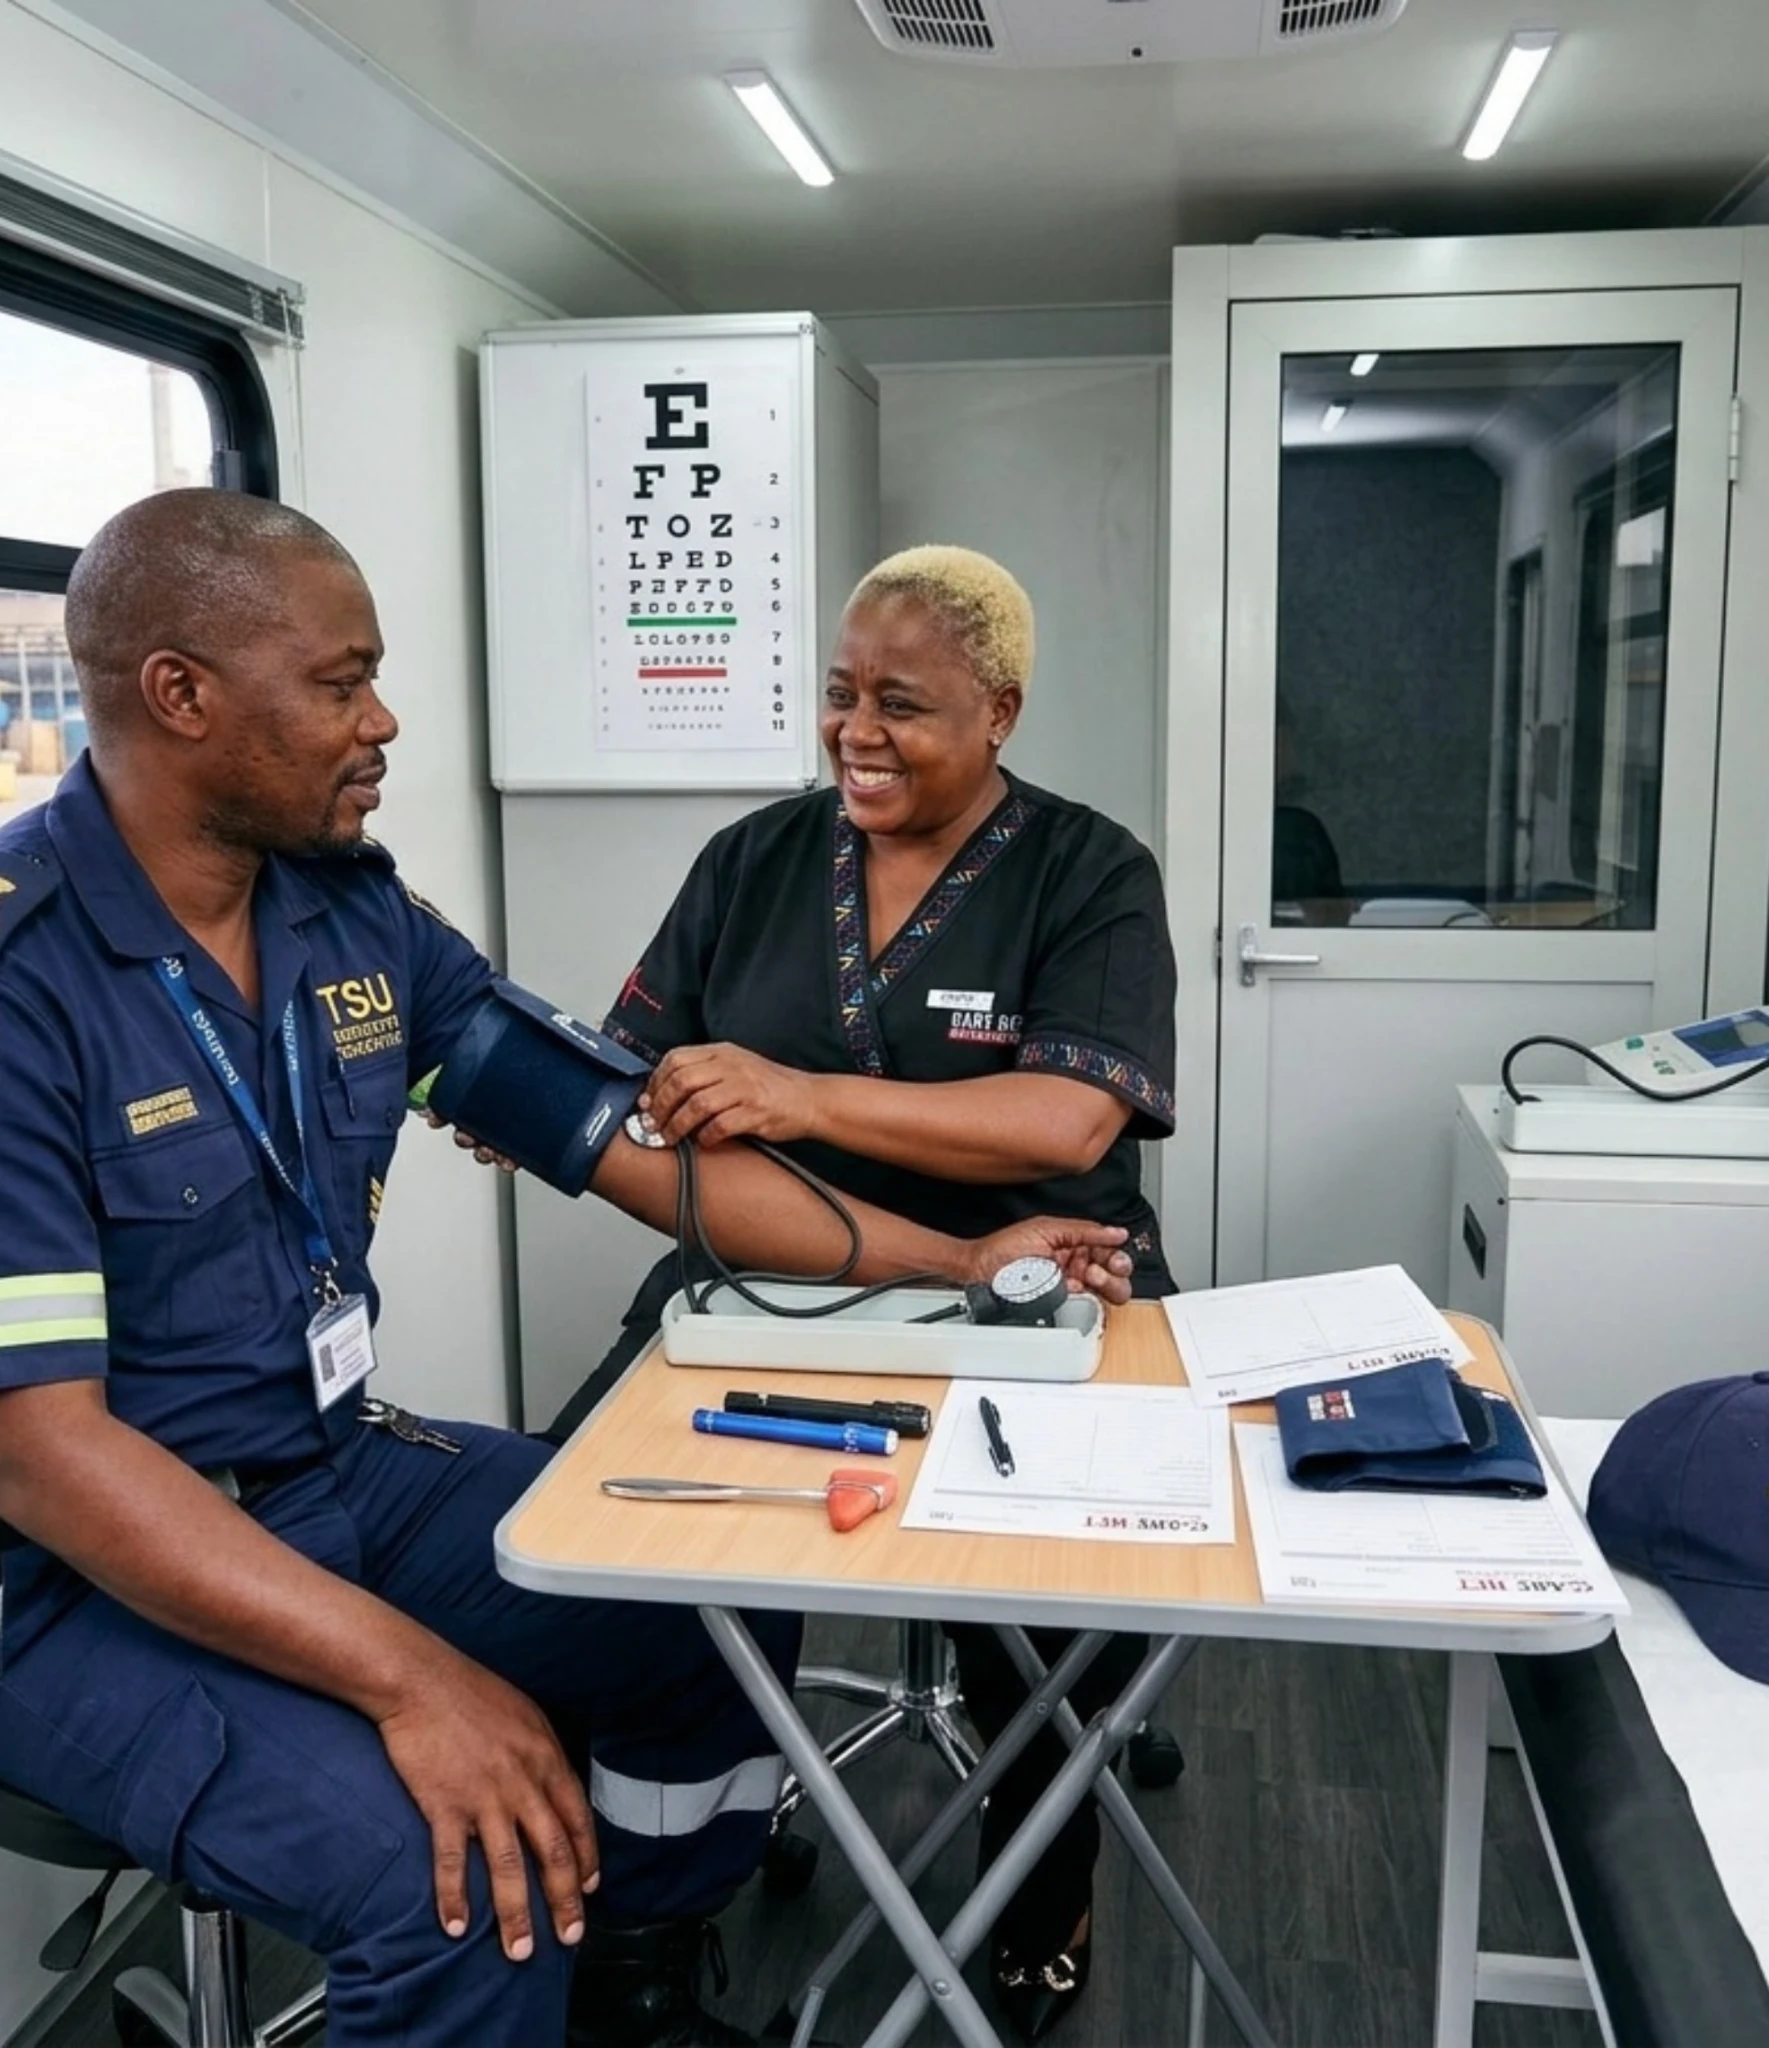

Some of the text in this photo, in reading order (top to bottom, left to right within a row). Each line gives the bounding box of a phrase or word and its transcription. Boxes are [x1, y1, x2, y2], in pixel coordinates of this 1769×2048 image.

[643, 382, 709, 450] E
[633, 463, 721, 499] F P
[769, 472, 780, 486] 2
[625, 514, 732, 539] T O Z
[770, 552, 780, 563] 4
[771, 577, 781, 591] 5
[772, 630, 782, 642] 7
[315, 973, 394, 1025] TSU
